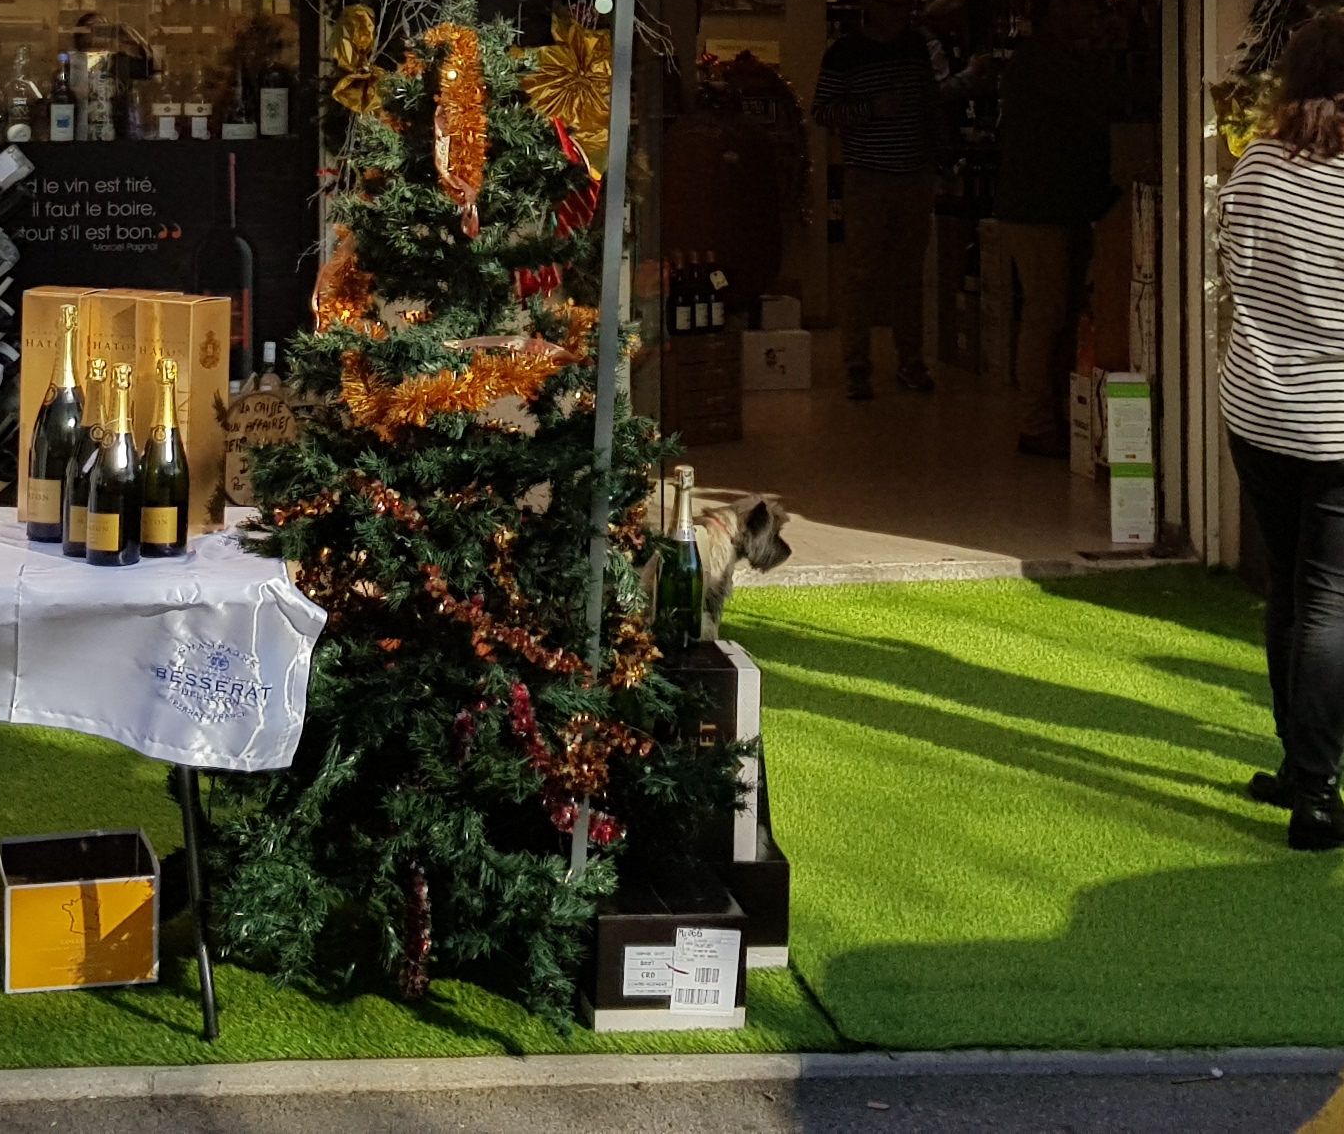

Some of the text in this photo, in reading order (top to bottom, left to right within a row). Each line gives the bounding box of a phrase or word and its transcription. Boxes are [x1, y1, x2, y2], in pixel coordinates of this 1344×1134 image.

[43, 178, 59, 194] le
[64, 178, 89, 194] vin
[95, 178, 121, 194] est
[126, 176, 156, 194] tiré,
[45, 201, 81, 217] faut
[86, 201, 102, 217] le
[107, 201, 156, 217] boire,
[85, 225, 112, 241] est
[93, 243, 157, 253] Marcel Pagnol
[156, 667, 273, 700] BESSERAT
